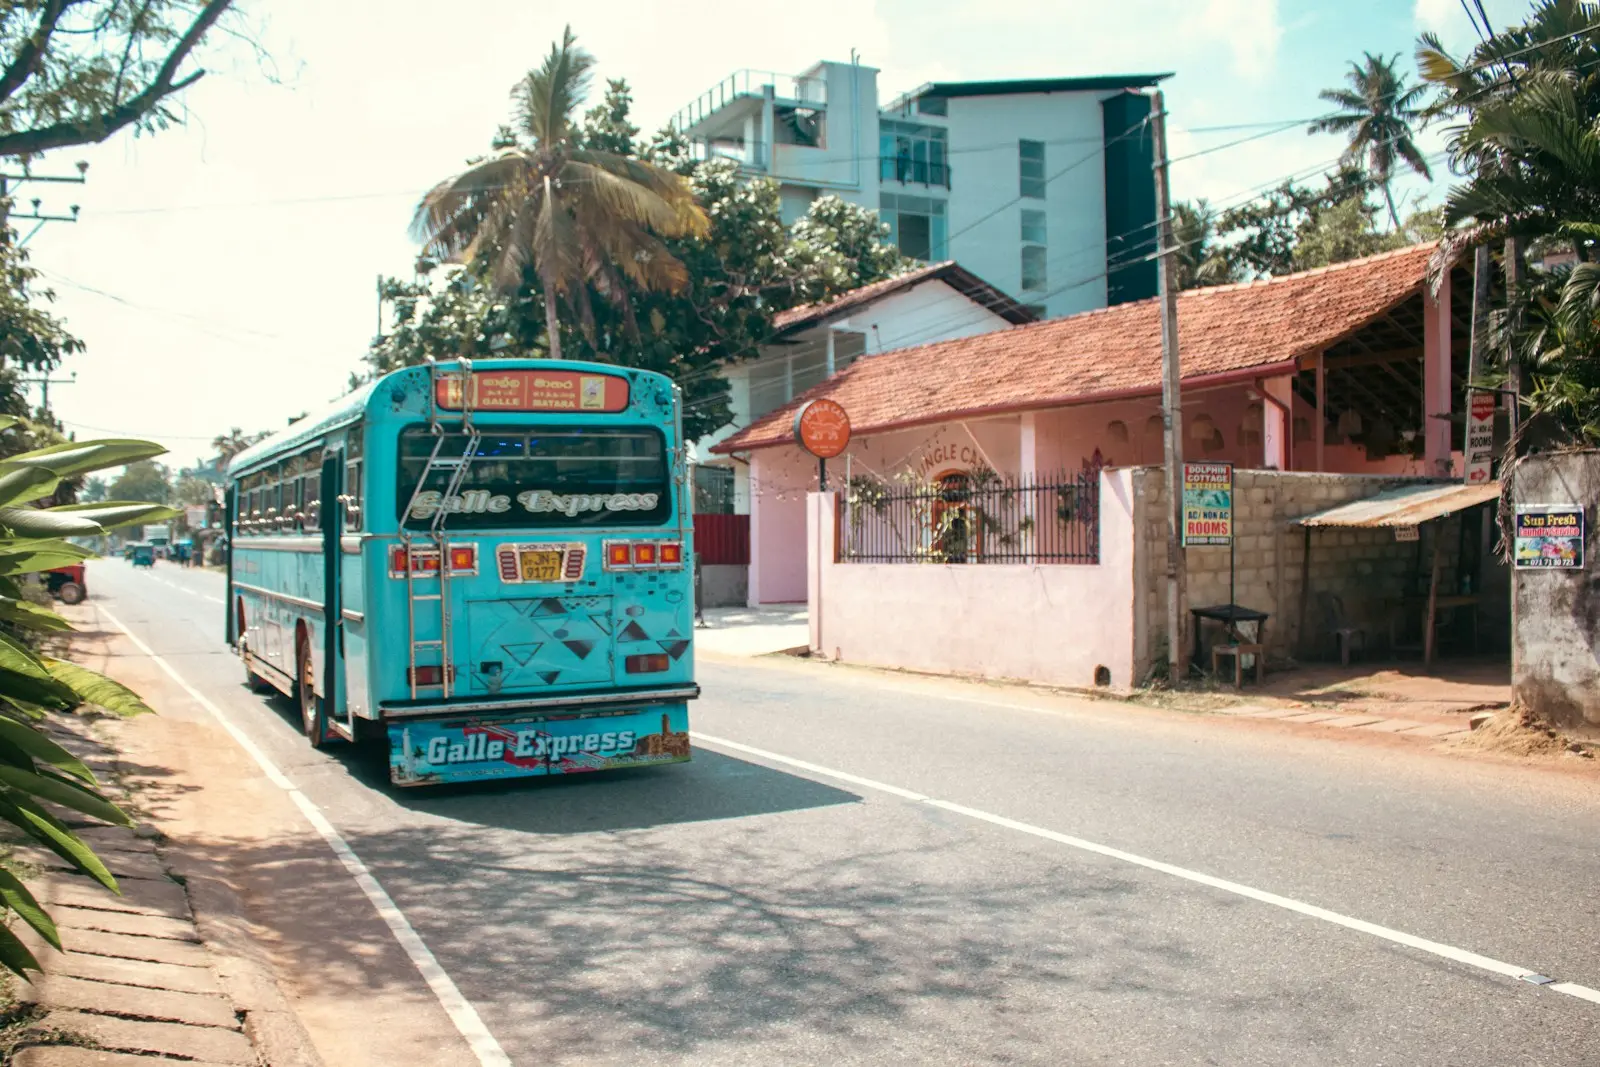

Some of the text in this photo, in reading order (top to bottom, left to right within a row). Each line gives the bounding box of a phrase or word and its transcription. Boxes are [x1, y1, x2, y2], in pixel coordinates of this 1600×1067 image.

[482, 398, 520, 406] GALLE
[1470, 436, 1492, 448] ROOMS
[1188, 465, 1227, 474] DOLPHIN
[1187, 474, 1228, 482] COTTAGE
[410, 489, 659, 519] Galle Express
[1203, 511, 1218, 520] NON
[1219, 511, 1229, 520] AC
[1523, 513, 1577, 526] Sun Fresh
[1187, 522, 1228, 535] ROOMS
[427, 733, 505, 765] Galle
[514, 729, 637, 762] Express
